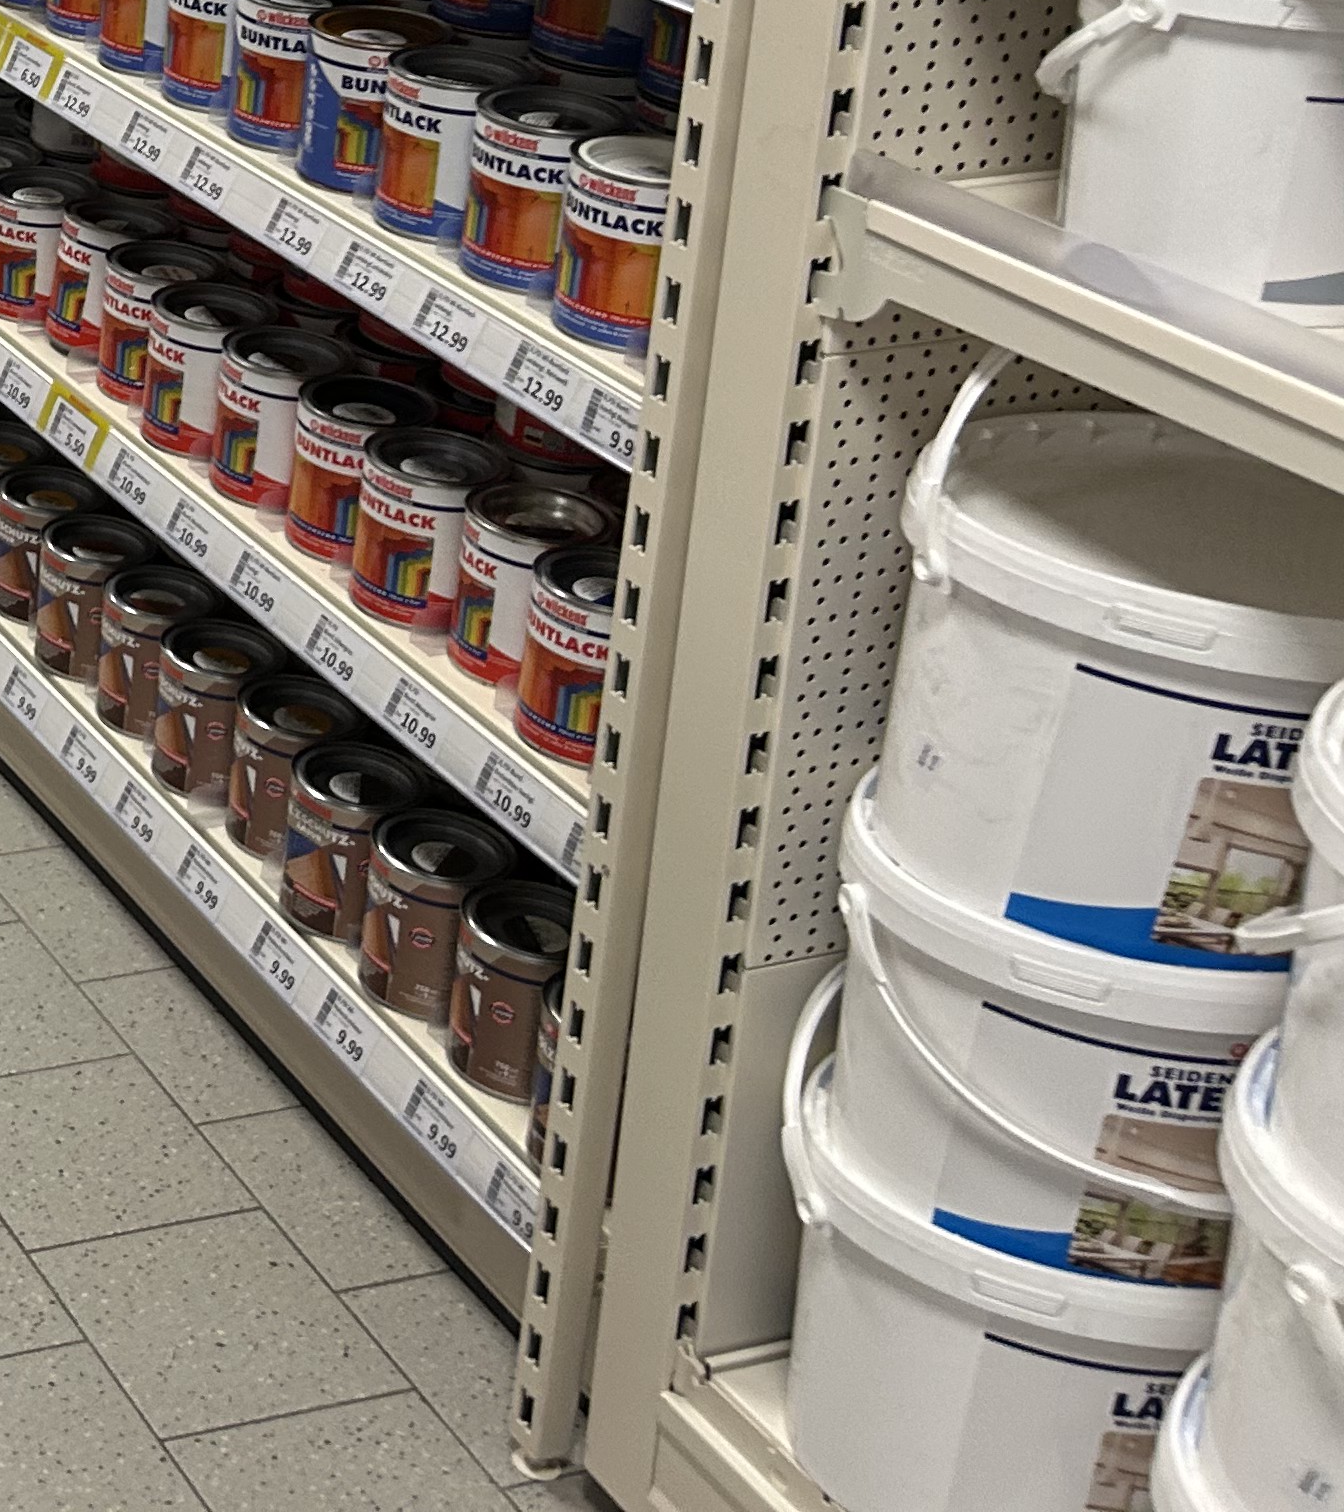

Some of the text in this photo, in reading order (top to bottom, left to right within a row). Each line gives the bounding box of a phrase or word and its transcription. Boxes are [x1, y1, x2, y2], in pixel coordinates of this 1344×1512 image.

[240, 25, 306, 54] BUNTLA
[20, 68, 40, 88] 6.50
[66, 95, 91, 118] 12.99
[134, 136, 162, 163] 12.99
[195, 175, 223, 201] 12.99
[280, 227, 313, 255] 12.99
[352, 271, 386, 302] 12.99
[430, 320, 468, 352] 12.99
[7, 383, 31, 408] 10.99
[523, 380, 564, 412] 12.99
[64, 433, 85, 456] 5.50
[609, 430, 635, 458] 9.9
[120, 477, 146, 505] 10.99
[180, 528, 208, 557] 10.99
[245, 581, 274, 612] 10.99
[321, 647, 353, 681] 10.99
[401, 712, 436, 748] 10.99
[1251, 722, 1305, 741] SEID
[1211, 733, 1300, 770] LAT
[76, 757, 97, 783] 9.99
[493, 789, 531, 828] 10.99
[131, 817, 153, 842] 9.99
[194, 881, 218, 909] 9.99
[270, 960, 296, 990] 9.99
[336, 1029, 363, 1062] 9.99
[427, 1123, 457, 1159] 9.99
